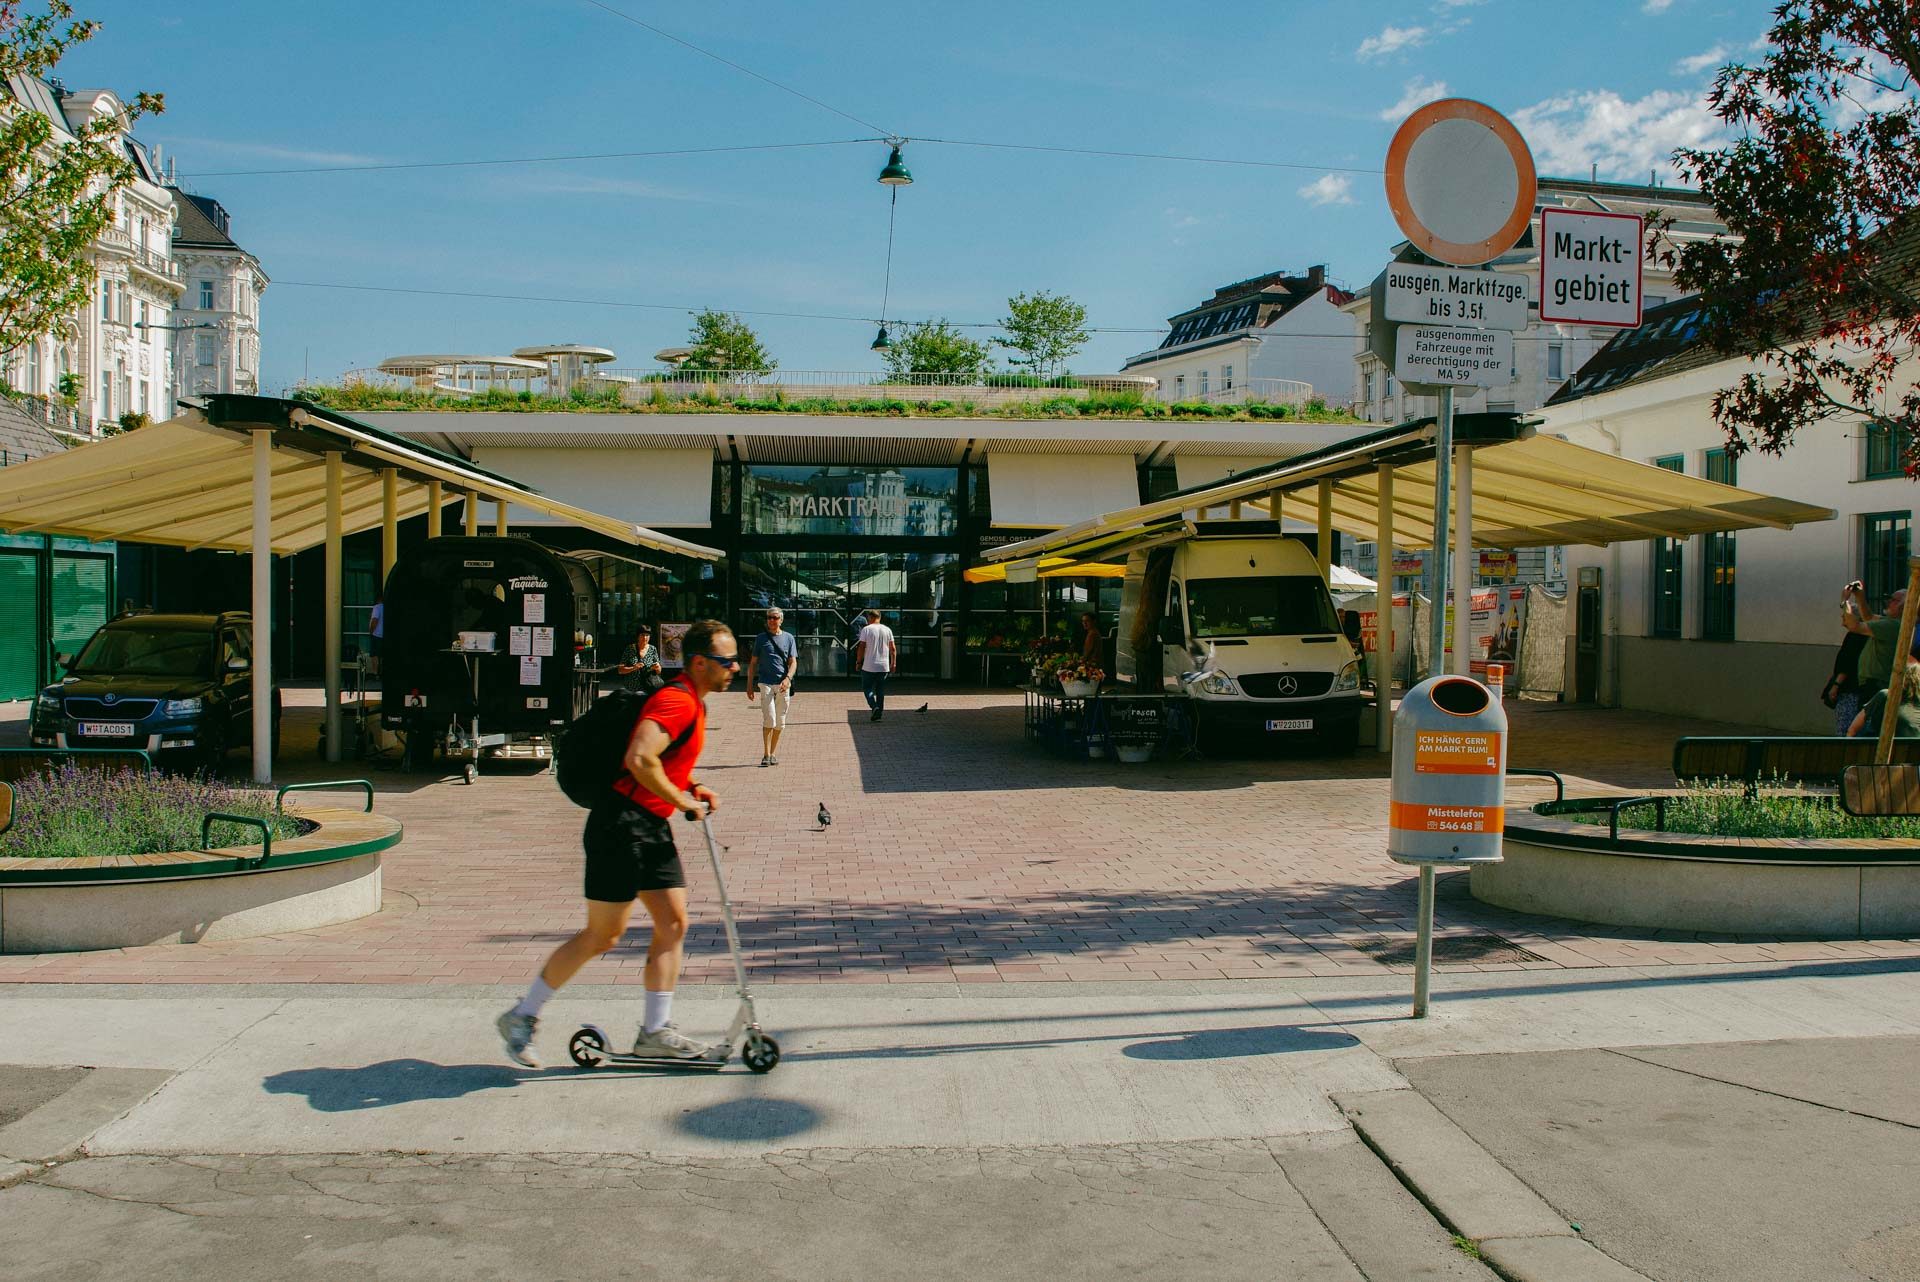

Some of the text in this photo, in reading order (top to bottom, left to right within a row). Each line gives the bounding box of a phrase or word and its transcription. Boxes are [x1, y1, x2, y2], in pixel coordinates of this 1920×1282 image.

[1554, 231, 1632, 264] Markt-
[1389, 273, 1526, 303] ausgen. Marktfzge.
[1554, 273, 1631, 306] gebiet
[1429, 297, 1484, 320] bis 3,5t
[1415, 329, 1495, 343] ausgenommen
[1415, 340, 1494, 356] Fahrzeuge mit
[1407, 353, 1501, 370] Berechtigung der
[1437, 368, 1470, 381] MA 59
[789, 495, 910, 517] MARKTRAUM
[1419, 736, 1434, 744] ICH
[1464, 737, 1487, 745] GERN
[1418, 744, 1488, 754] AM MARKT RUM!
[1427, 807, 1484, 818] Misttelefon
[1439, 821, 1473, 831] 546 48
